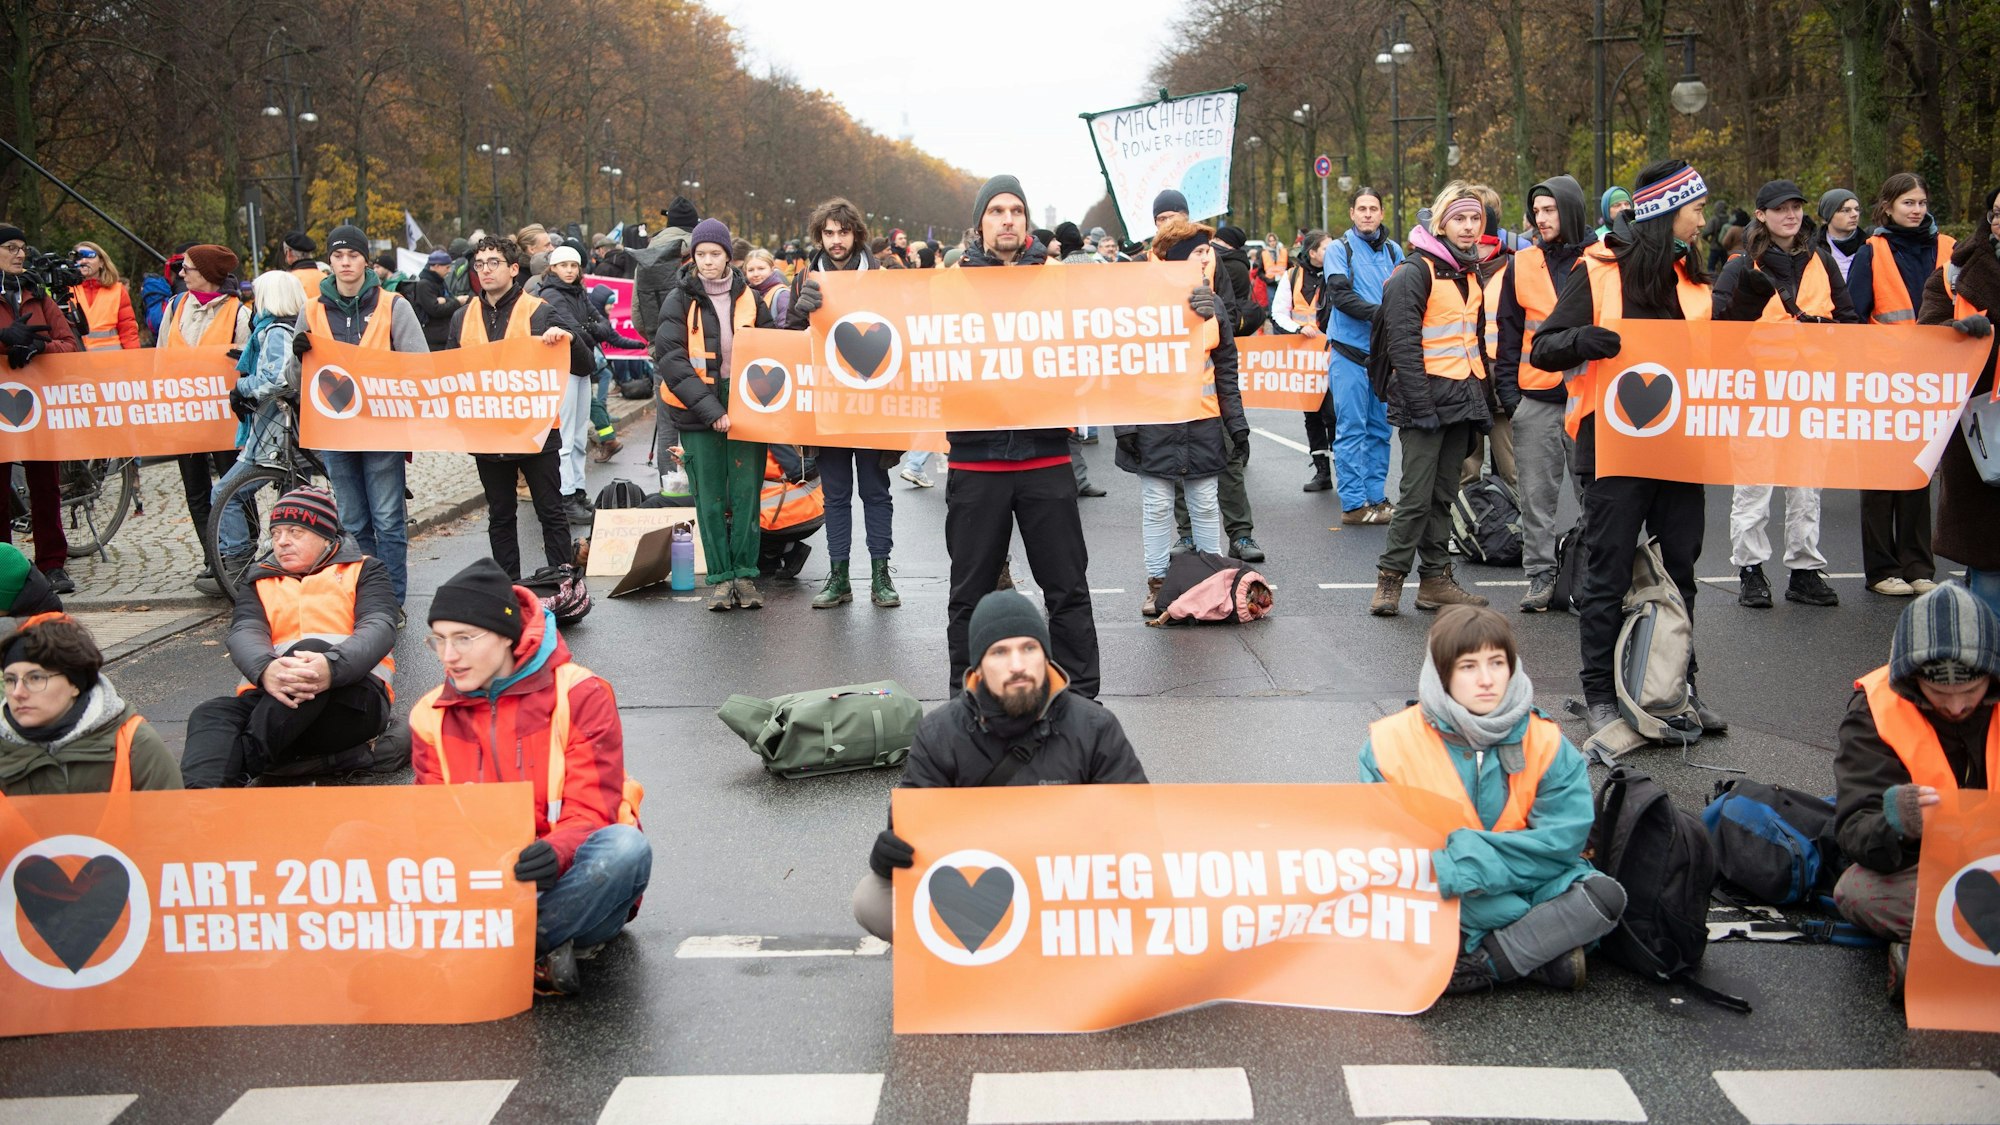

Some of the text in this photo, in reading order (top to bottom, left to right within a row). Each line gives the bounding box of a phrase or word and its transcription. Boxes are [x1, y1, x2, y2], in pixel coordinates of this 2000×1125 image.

[905, 305, 1190, 345] WEG VON FOSSIL
[909, 350, 972, 383] HIN
[980, 348, 1023, 380] ZU
[1032, 341, 1190, 379] GERECHT
[1247, 350, 1330, 371] POLITIK
[42, 376, 231, 405] WEG VON FOSSIL
[361, 368, 560, 397] WEG VON FOSSIL
[1253, 371, 1329, 393] FOLGEN
[1686, 369, 1969, 404] WEG VON FOSSIL
[46, 399, 232, 430] HIN ZU GERECHT
[367, 395, 561, 419] HIN ZU GERECHT
[796, 389, 941, 419] HIN ZU GERE
[1684, 405, 1955, 442] HIN ZU GERECH
[159, 861, 265, 907] ART.
[276, 859, 378, 905] 20A
[387, 857, 457, 904] GG
[1035, 847, 1439, 901] WEG VON FOSSIL
[163, 904, 514, 953] LEBEN SCHÜTZEN
[1040, 893, 1438, 956] HIN ZU GERECHT
